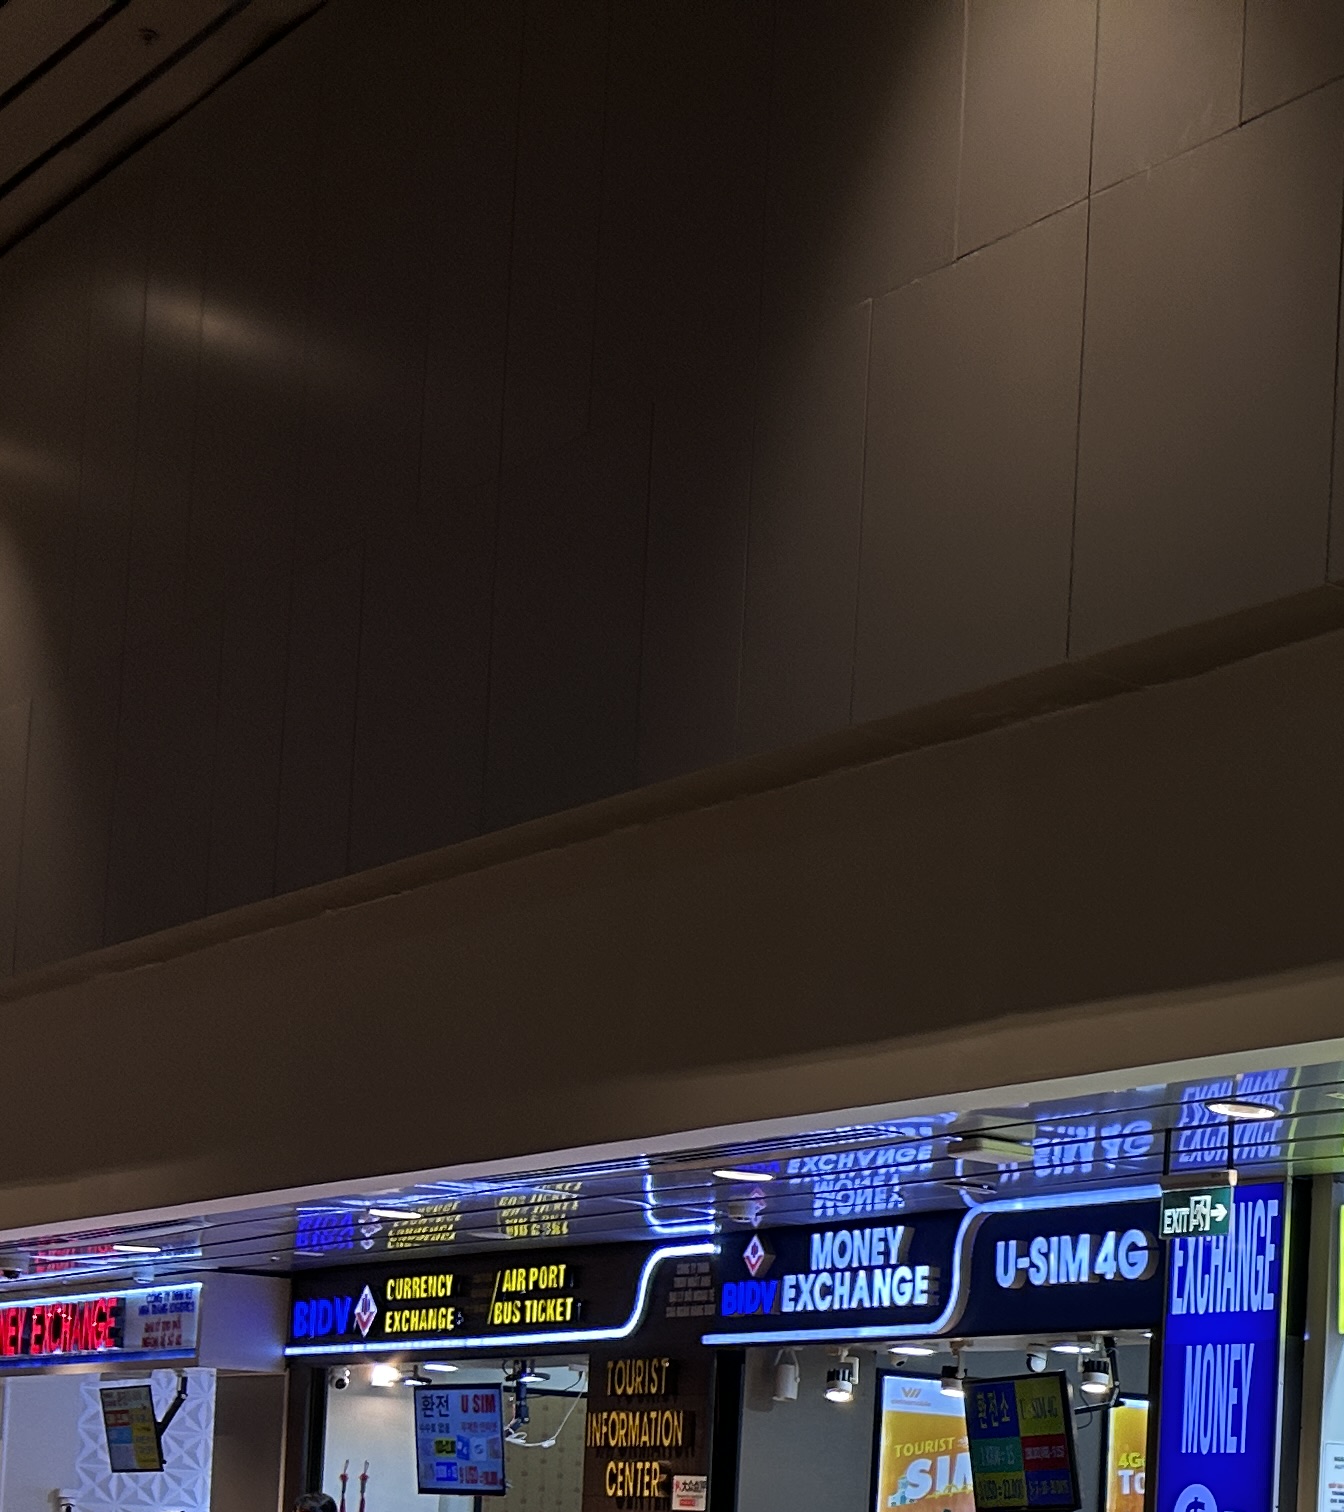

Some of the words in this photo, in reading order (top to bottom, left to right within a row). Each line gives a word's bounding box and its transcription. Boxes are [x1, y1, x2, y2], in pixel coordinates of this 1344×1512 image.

[1163, 1208, 1189, 1234] EXIT
[810, 1225, 904, 1271] MONEY
[995, 1233, 1091, 1289] U-SIM
[1094, 1229, 1149, 1280] 4G
[1170, 1200, 1278, 1315] EXCHANGE
[387, 1274, 453, 1300] CURRENCY
[722, 1280, 778, 1316] BIDV
[781, 1265, 930, 1314] EXCHANGE
[294, 1296, 351, 1338] BIDV
[385, 1307, 455, 1333] EXCHANGE
[493, 1301, 521, 1325] BUS
[524, 1298, 573, 1322] TICKET
[606, 1357, 669, 1396] TOURIST
[421, 1394, 450, 1418] 환전
[1181, 1343, 1255, 1456] MONEY
[586, 1411, 683, 1447] INFORMATION
[894, 1437, 955, 1458] TOURIST
[606, 1461, 662, 1497] CENTER
